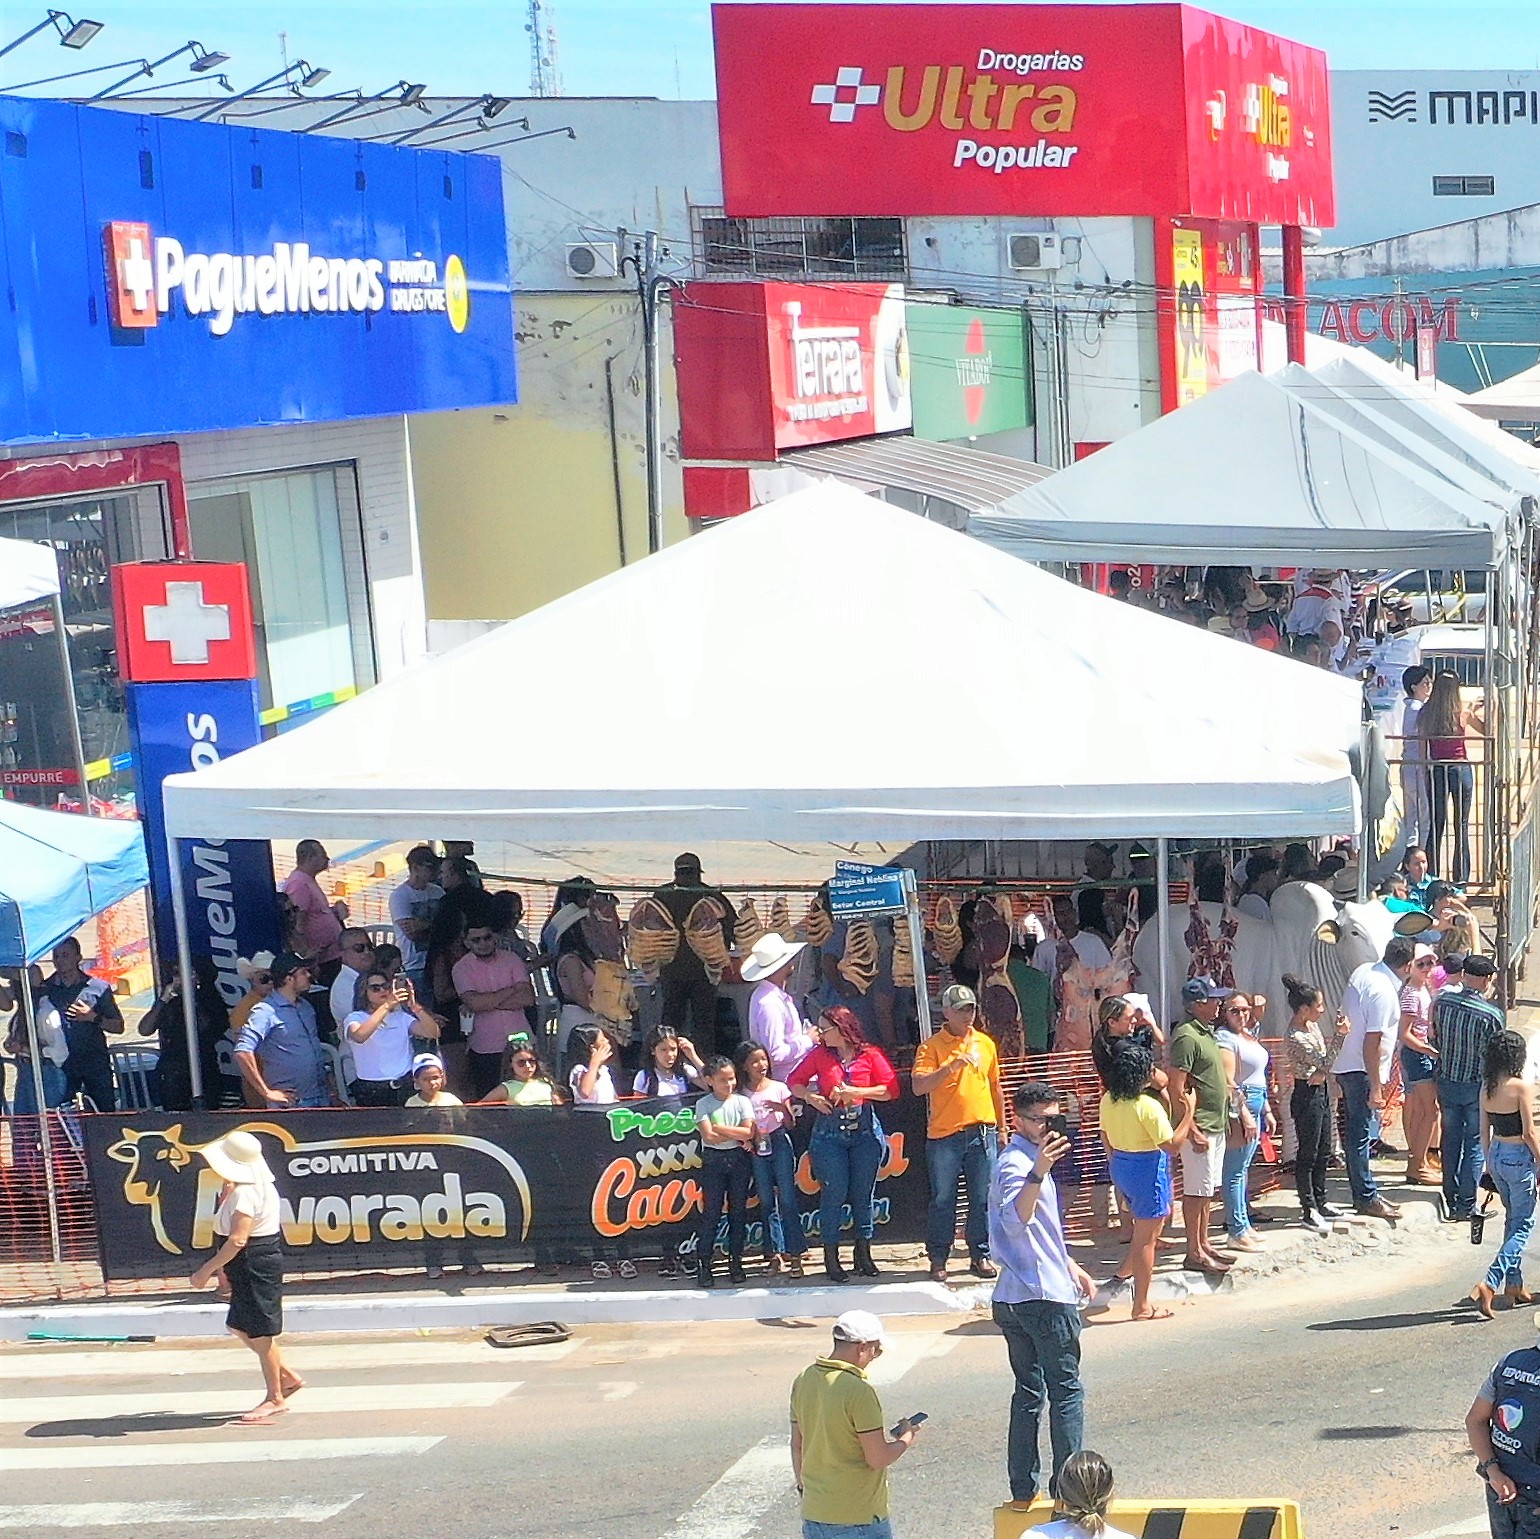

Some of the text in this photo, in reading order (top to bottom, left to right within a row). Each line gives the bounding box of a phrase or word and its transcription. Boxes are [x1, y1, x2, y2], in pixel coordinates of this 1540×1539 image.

[977, 49, 1084, 75] Drogarias
[883, 66, 1077, 132] Ultra
[953, 139, 1079, 173] Popular
[155, 237, 384, 335] PagueMenos
[4, 771, 64, 783] EMPURRE
[855, 898, 885, 908] Central
[288, 1152, 438, 1177] COMITIVA
